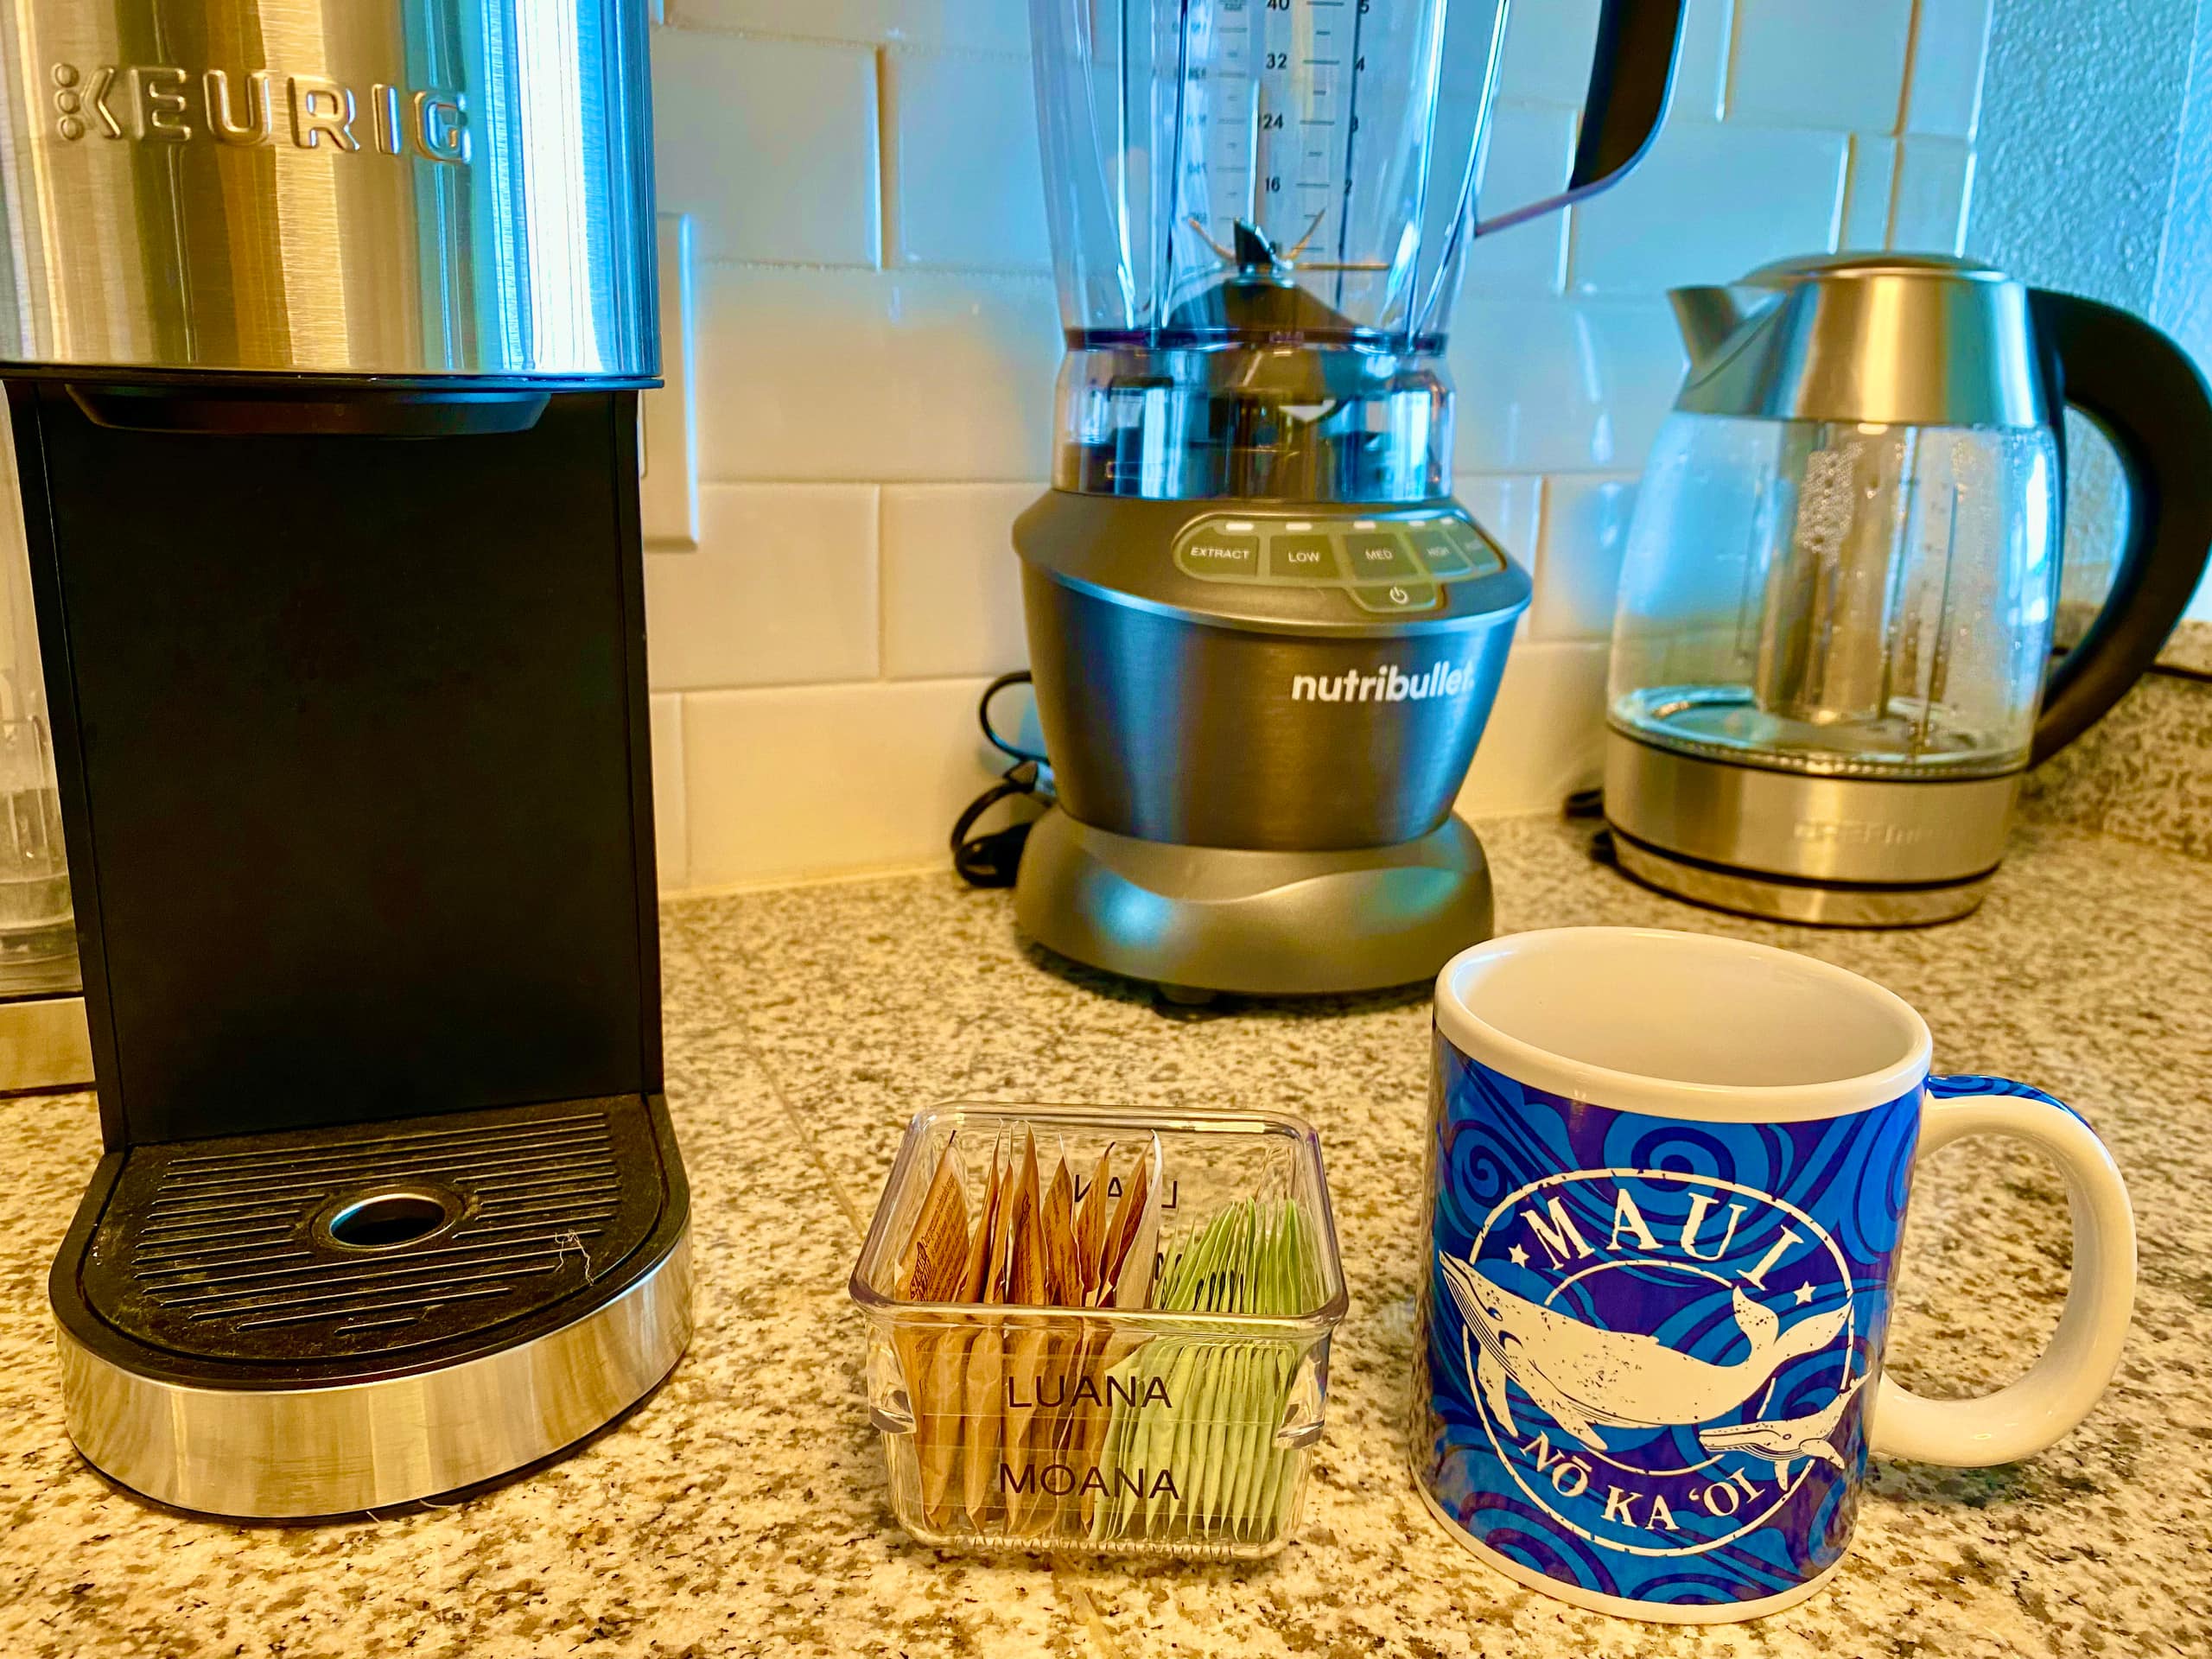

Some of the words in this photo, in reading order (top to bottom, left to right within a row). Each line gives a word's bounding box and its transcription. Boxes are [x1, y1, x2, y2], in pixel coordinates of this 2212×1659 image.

[1266, 53, 1287, 69] 32
[51, 62, 472, 164] KEURIG
[1262, 113, 1284, 129] 24
[1265, 176, 1281, 192] 16
[1190, 547, 1250, 561] EXTRACT
[1287, 550, 1320, 563] LOW
[1365, 548, 1393, 561] MED
[1520, 1188, 1805, 1292] MAUI
[1007, 1375, 1173, 1409] LUANA
[999, 1462, 1180, 1501] MOANA
[1600, 1486, 1680, 1531] KA
